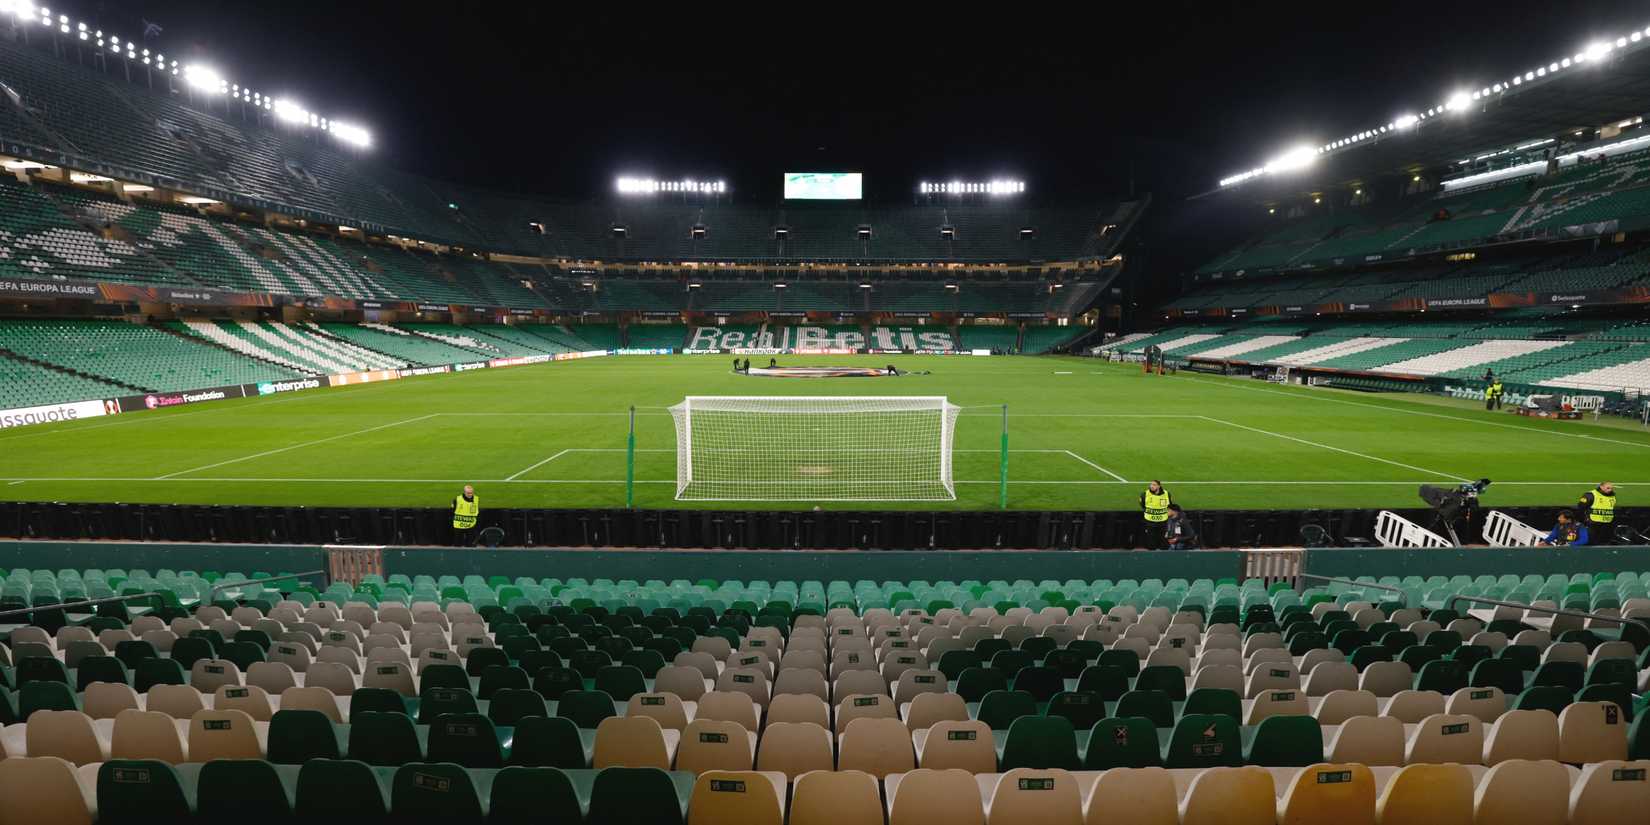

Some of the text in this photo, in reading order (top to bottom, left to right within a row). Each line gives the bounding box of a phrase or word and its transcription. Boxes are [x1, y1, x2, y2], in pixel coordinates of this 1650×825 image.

[20, 283, 59, 292] EUROPA
[61, 285, 97, 294] LEAGUE
[796, 327, 953, 350] Betis
[259, 379, 319, 395] enterprise
[183, 391, 224, 402] Foundation
